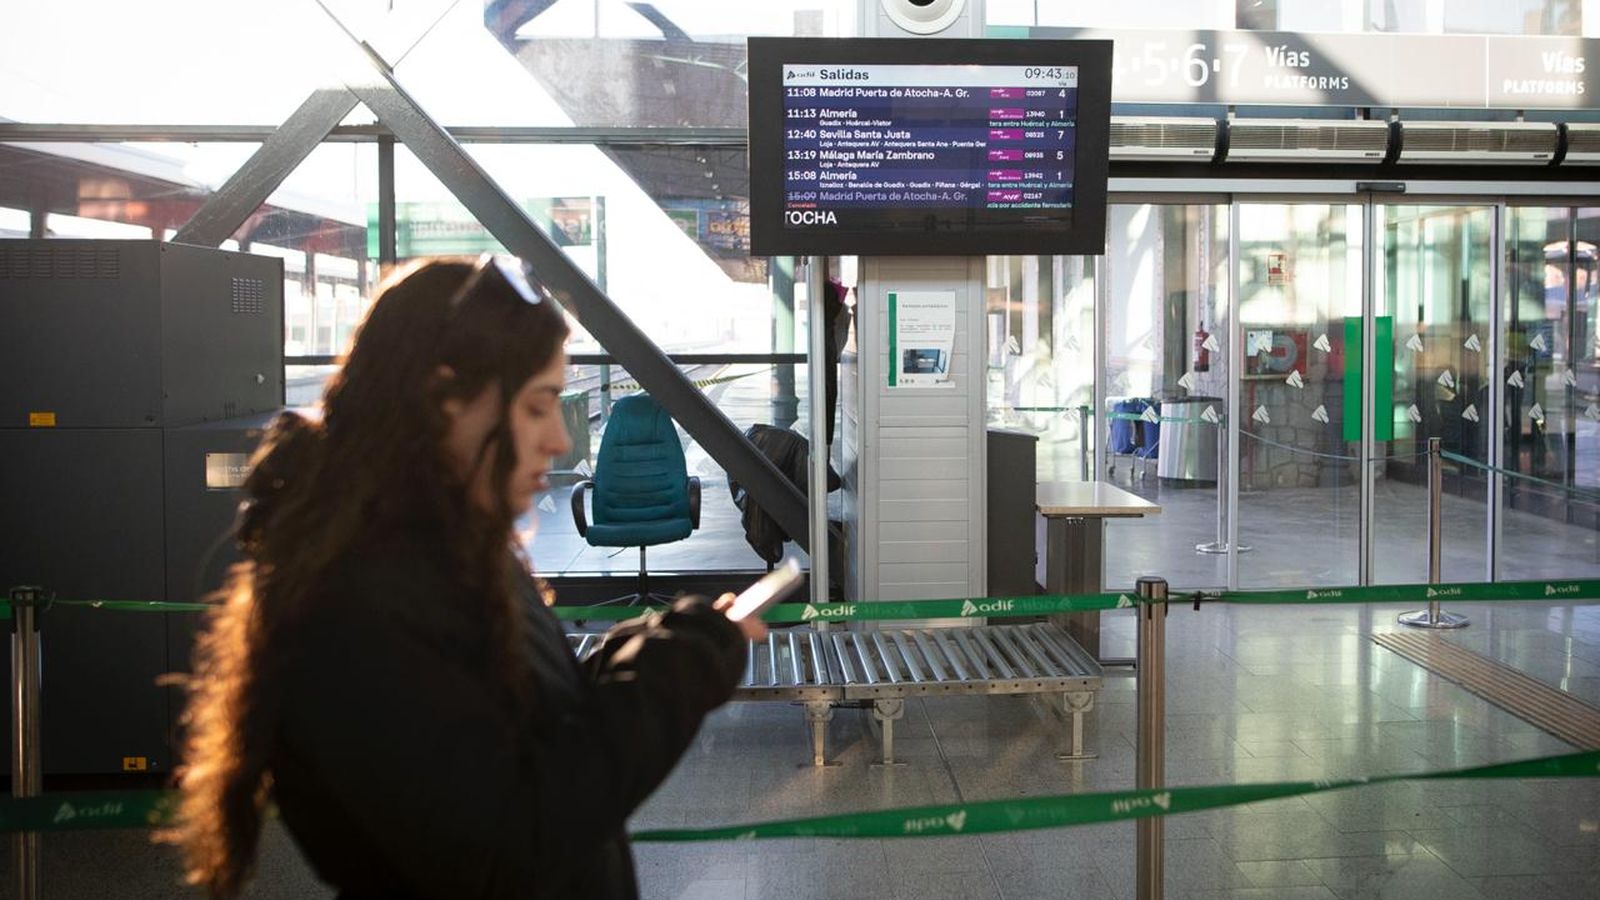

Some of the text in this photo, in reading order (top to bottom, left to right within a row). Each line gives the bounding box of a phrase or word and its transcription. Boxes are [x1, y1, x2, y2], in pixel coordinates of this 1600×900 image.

[1265, 45, 1310, 67] Vías
[1541, 51, 1586, 73] Vías
[819, 68, 869, 80] Salidas
[1264, 76, 1349, 90] PLATFORMS
[1503, 79, 1586, 94] PLATFORMS
[787, 88, 816, 97] 11:08
[819, 88, 854, 97] Madrid
[855, 88, 888, 97] Puerta
[889, 88, 902, 97] de
[955, 88, 970, 98] Gr.
[1058, 89, 1066, 97] 4
[787, 109, 816, 118] 11:13
[819, 108, 858, 118] Almería
[1059, 110, 1064, 119] 1
[787, 130, 816, 139] 12:40
[819, 130, 852, 139] Sevilla
[854, 130, 882, 139] Santa
[884, 130, 911, 139] Justa
[1058, 131, 1064, 140] 7
[787, 150, 816, 160] 13:19
[820, 150, 855, 161] Málaga
[857, 150, 884, 160] María
[885, 150, 935, 160] Zambrano
[1057, 151, 1064, 160] 5
[787, 171, 816, 180] 15:08
[820, 170, 858, 180] Almería
[1057, 171, 1062, 180] 1
[820, 191, 853, 200] Madrid
[855, 191, 887, 200] Puerta
[889, 191, 901, 200] de
[953, 191, 968, 200] Gr.
[785, 211, 838, 224] TOCHA
[1556, 584, 1580, 593] adif
[820, 604, 857, 616] adif
[979, 599, 1015, 612] adif
